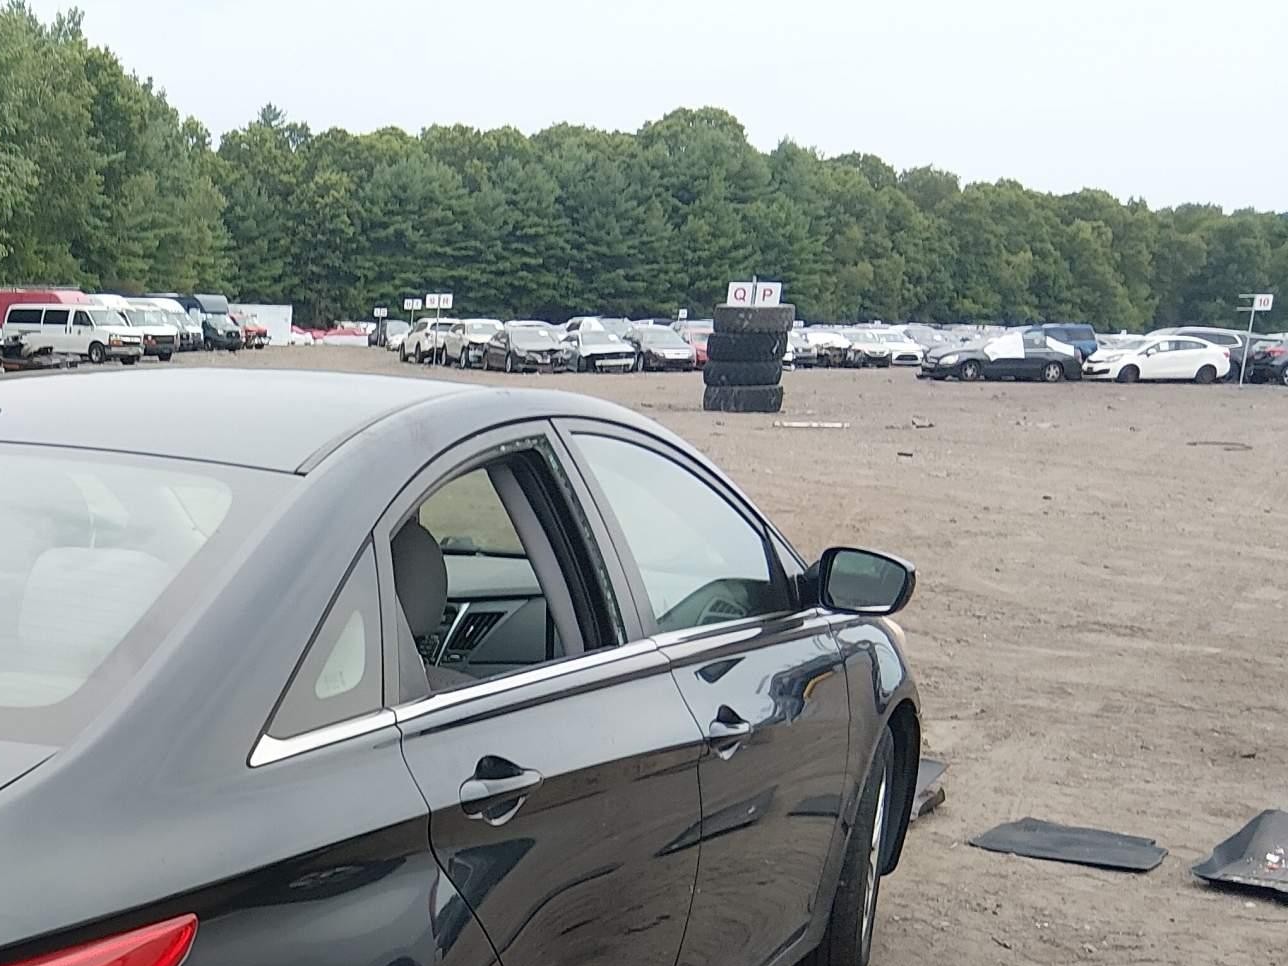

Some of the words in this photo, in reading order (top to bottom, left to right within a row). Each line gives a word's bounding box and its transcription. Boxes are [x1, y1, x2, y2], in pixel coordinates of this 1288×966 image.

[734, 287, 746, 302] Q
[762, 288, 773, 302] P
[1259, 297, 1270, 307] 10
